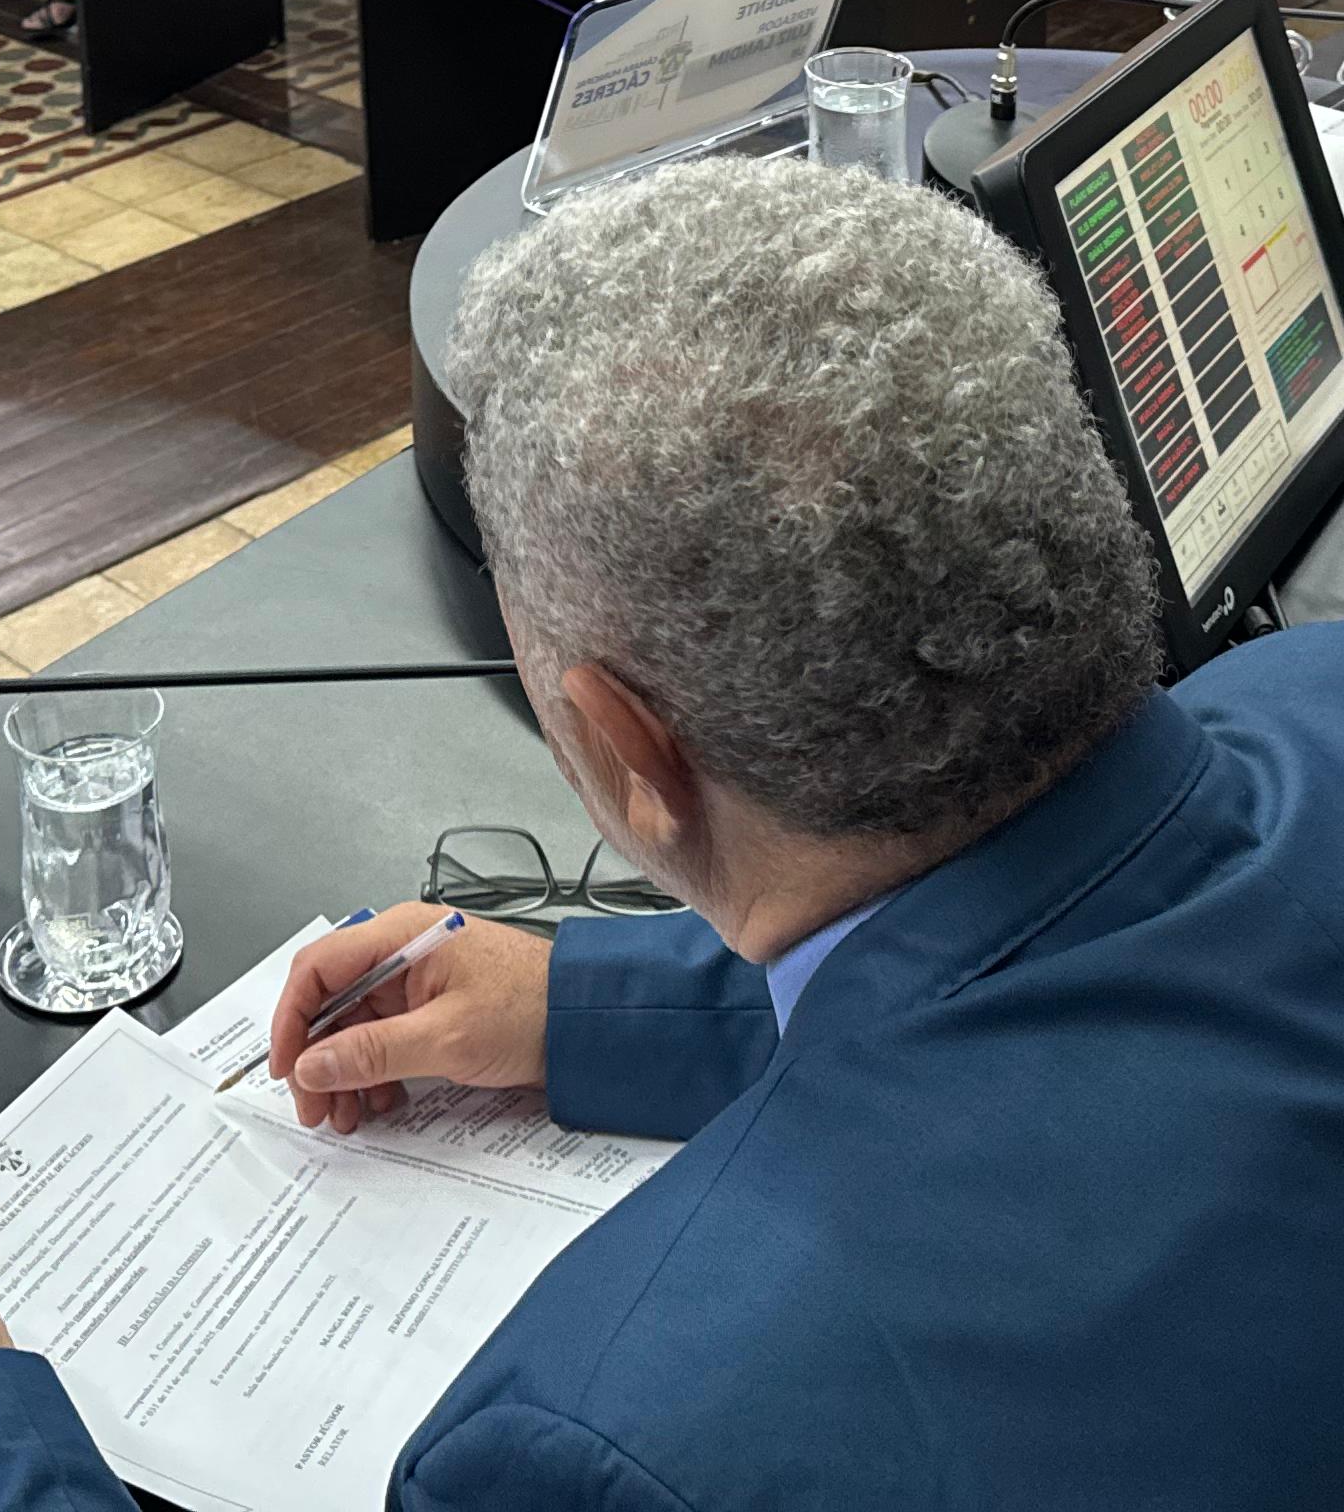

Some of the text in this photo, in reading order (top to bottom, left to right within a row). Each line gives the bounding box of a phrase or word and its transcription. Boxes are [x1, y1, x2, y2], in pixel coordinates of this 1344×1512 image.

[1187, 76, 1224, 125] 00:00
[1243, 156, 1251, 173] 2
[1262, 139, 1270, 155] 3
[1257, 203, 1265, 219] 5
[1276, 185, 1284, 200] 6
[17, 1172, 57, 1208] MUNICIPAL
[62, 1133, 93, 1164] CÁCERES
[445, 1216, 472, 1247] PEREIRA
[319, 1295, 360, 1347] MANGA ROSA
[337, 1303, 374, 1350] PRESIDENTE
[294, 1403, 345, 1470] PASTOR JÚNIOR
[317, 1428, 349, 1467] RELATOR
